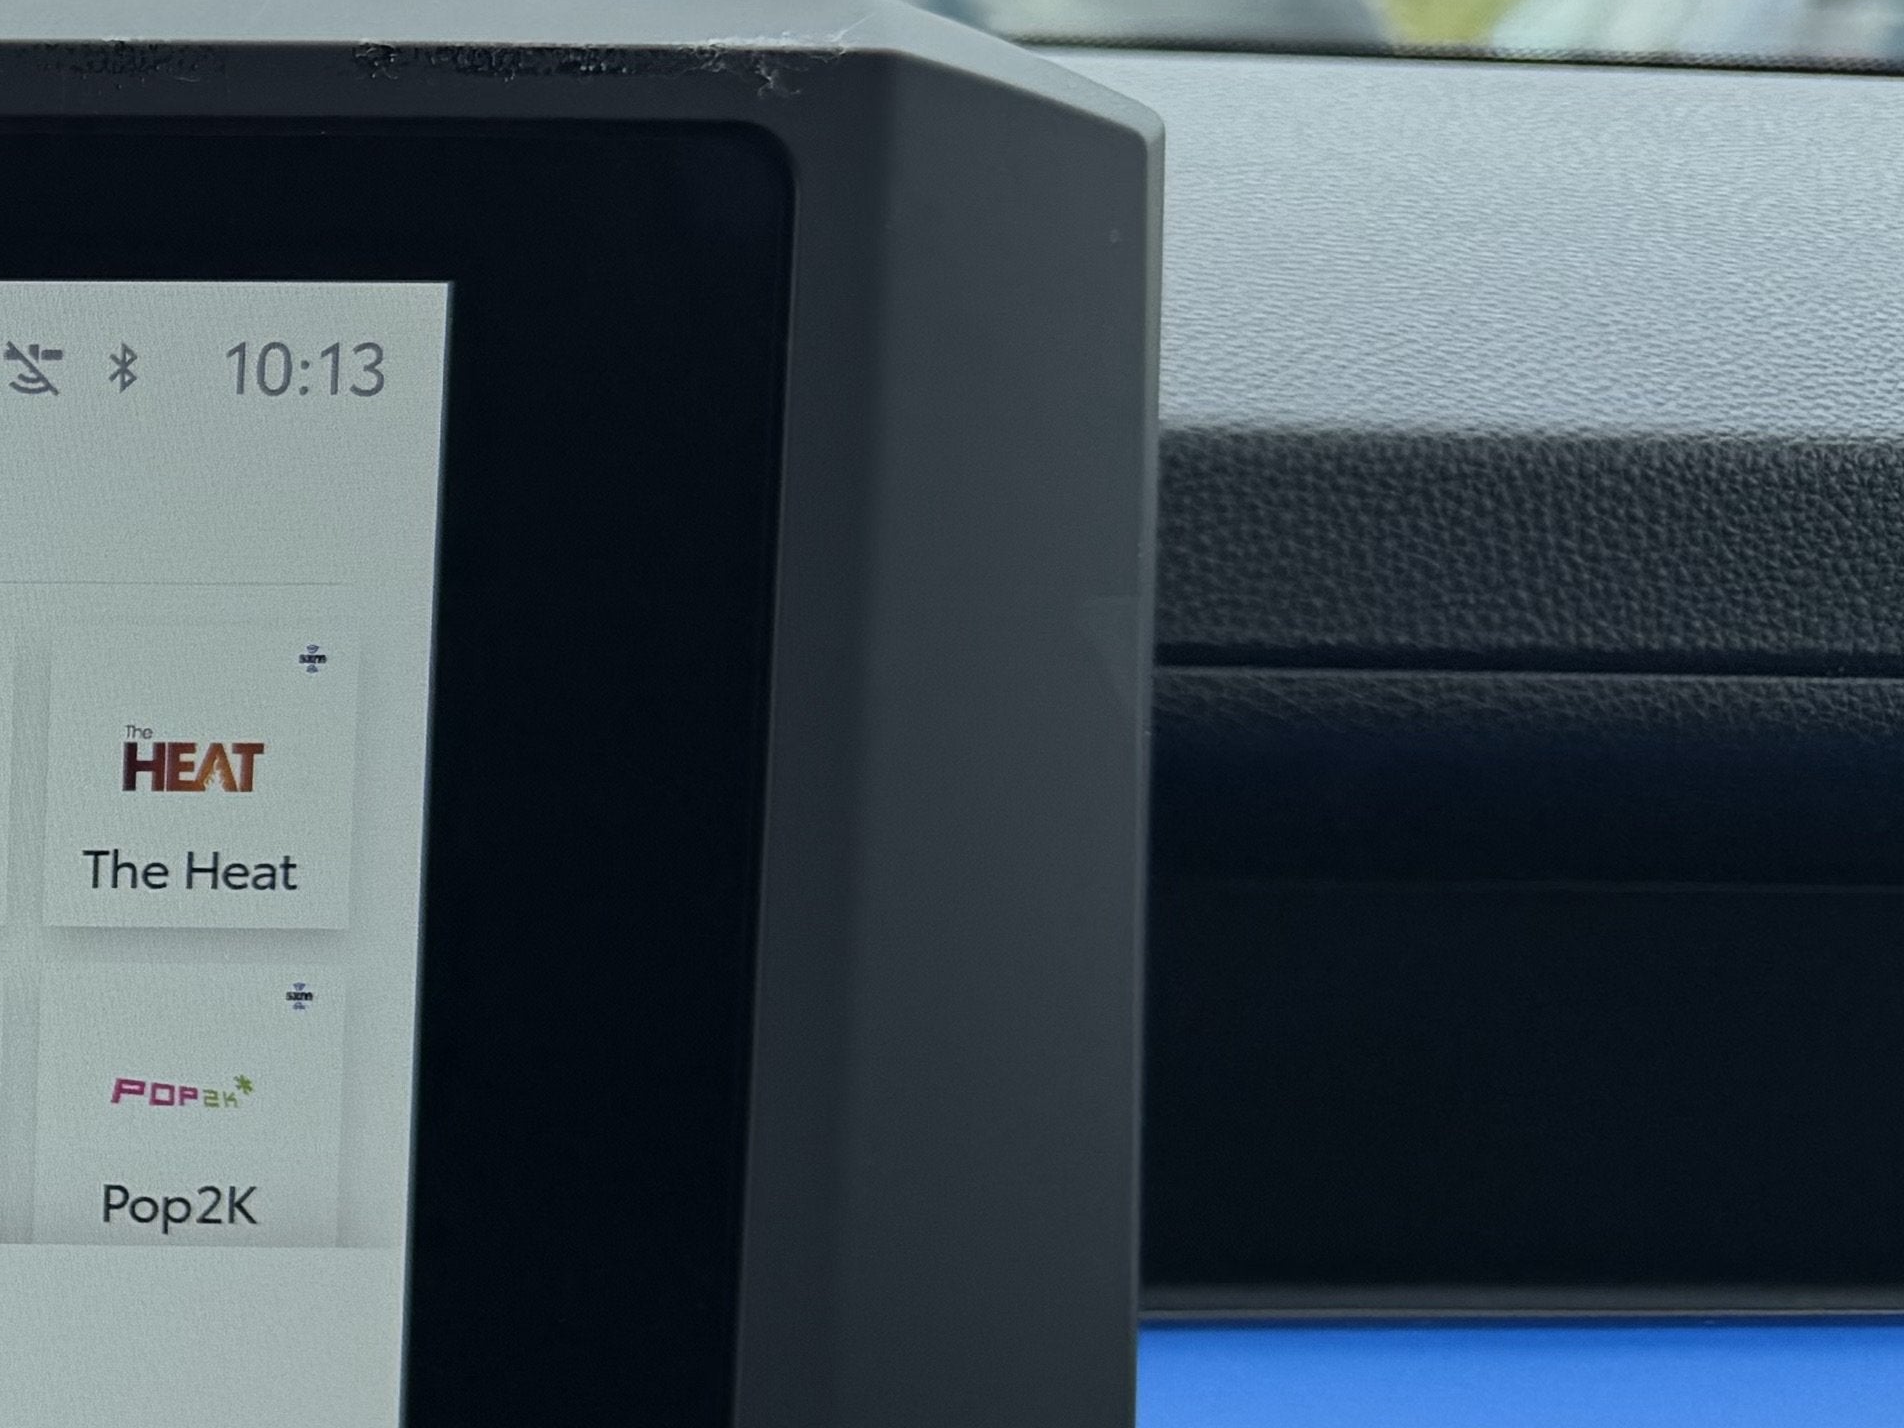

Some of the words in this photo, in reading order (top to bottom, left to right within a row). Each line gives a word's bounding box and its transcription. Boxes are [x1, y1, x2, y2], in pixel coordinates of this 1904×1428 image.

[227, 342, 386, 398] 10:13
[125, 724, 154, 740] The
[122, 741, 265, 793] HEAT
[83, 849, 171, 891] The
[187, 852, 299, 892] Heat
[104, 1185, 258, 1236] Pop2K
